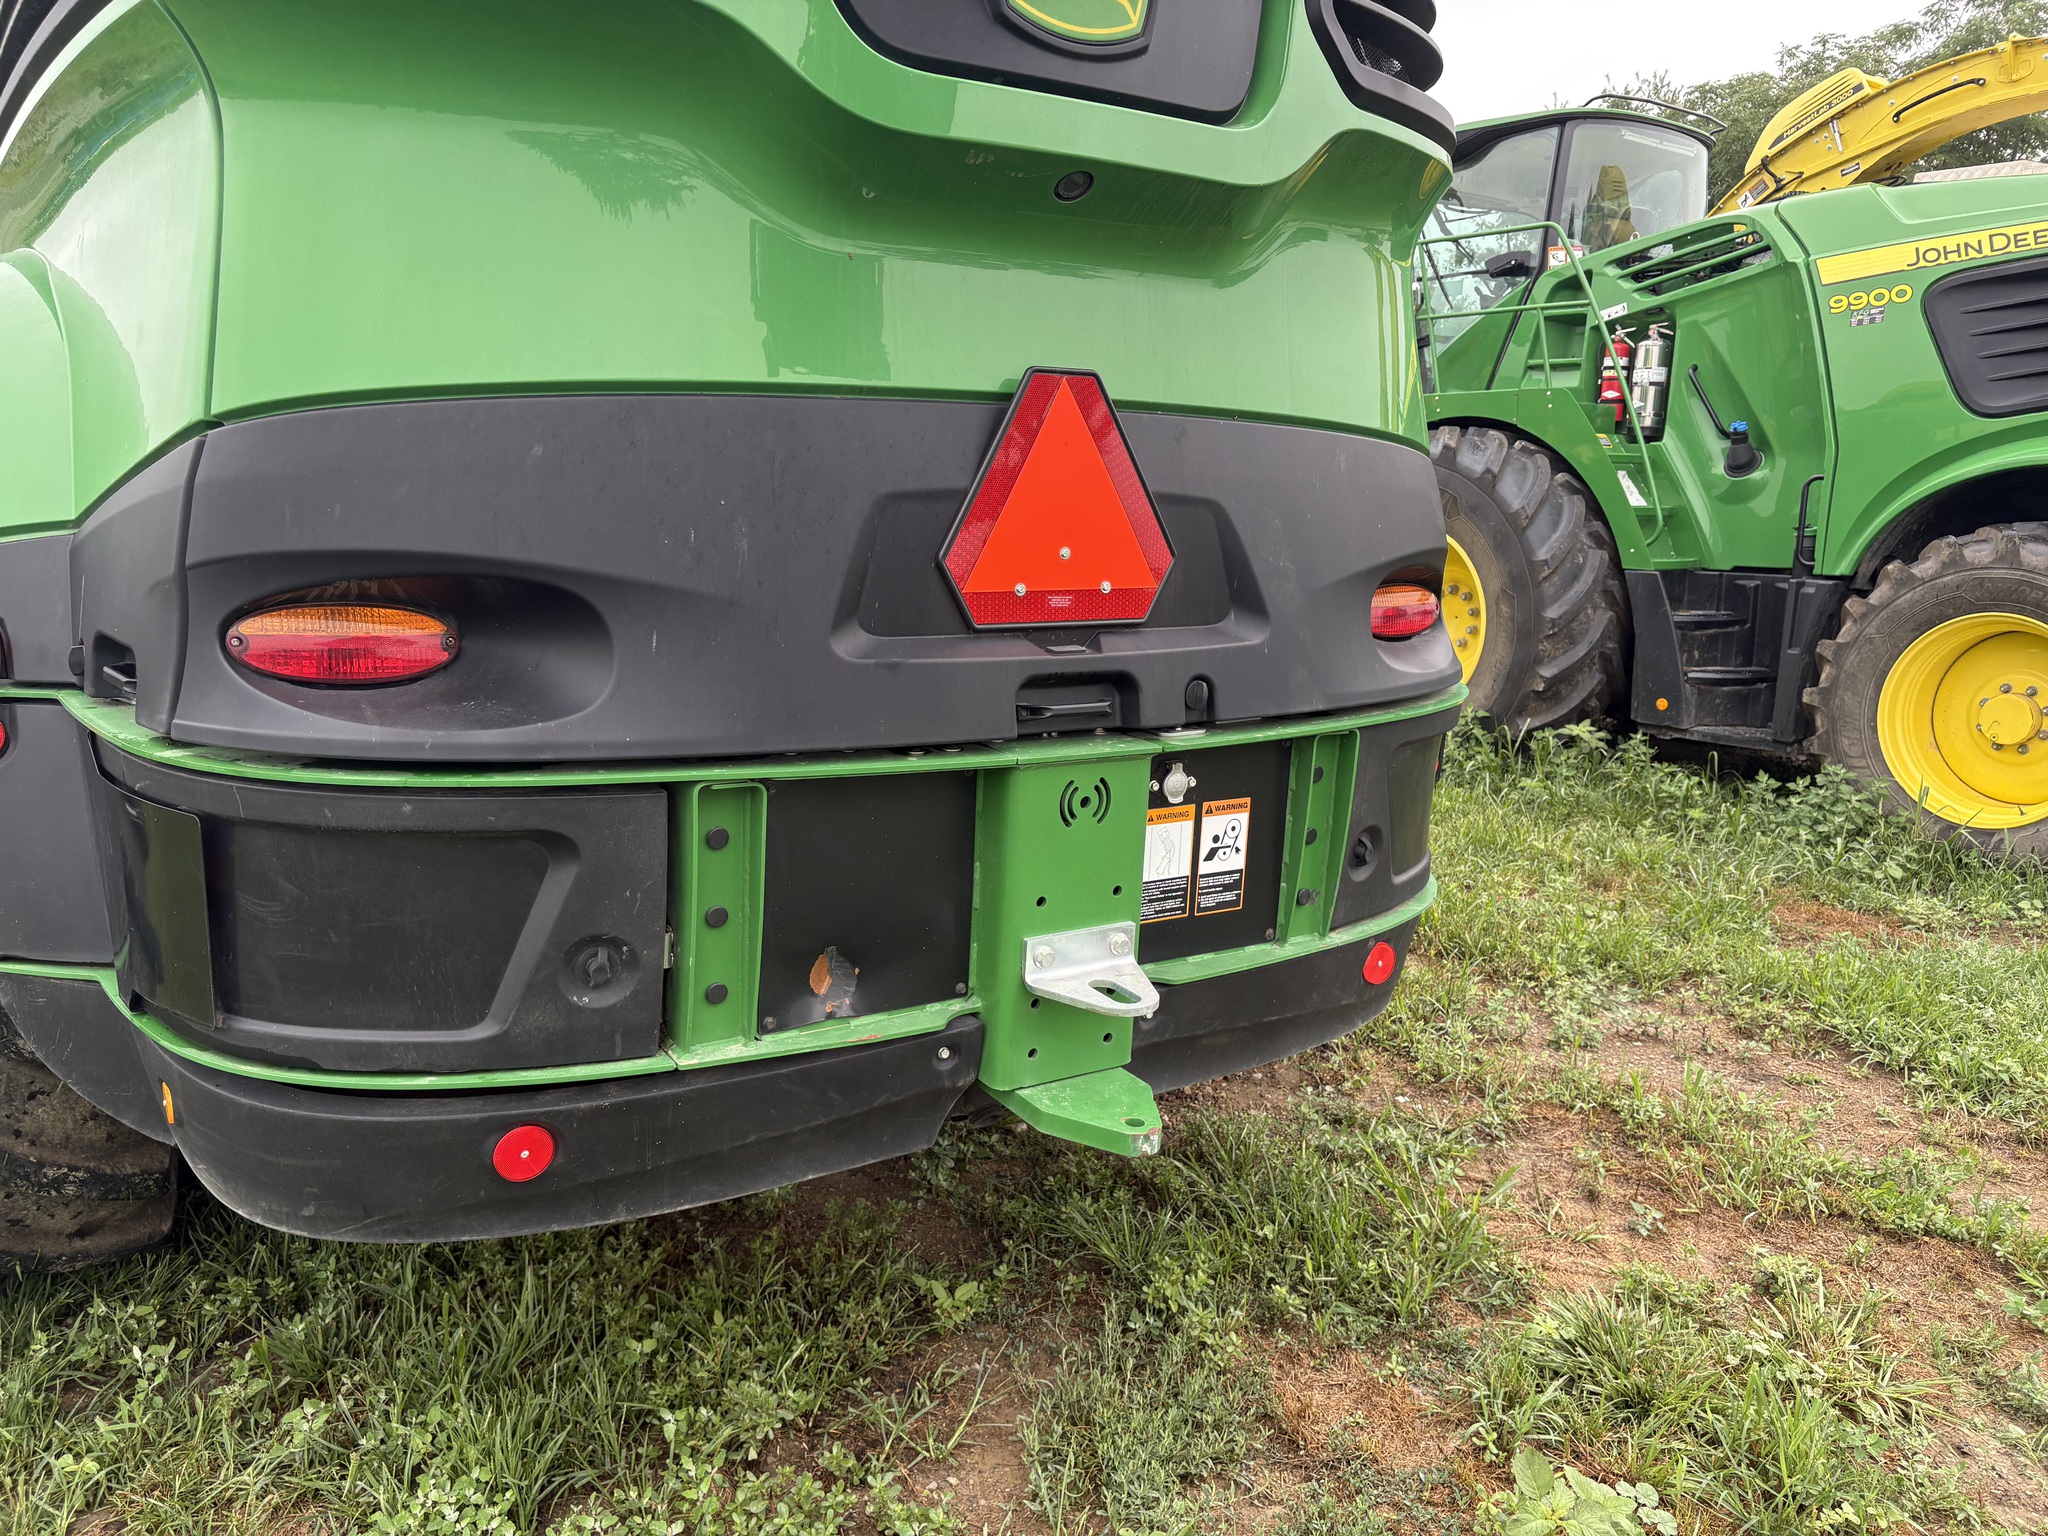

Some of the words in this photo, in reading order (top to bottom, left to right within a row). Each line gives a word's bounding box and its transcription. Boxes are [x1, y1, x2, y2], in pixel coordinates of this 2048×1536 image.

[1782, 103, 1830, 138] HarvestLab
[1831, 89, 1854, 107] 3000
[1907, 239, 1983, 267] JOHN
[1828, 284, 1913, 314] 9900
[1156, 811, 1189, 821] WARNING
[1214, 802, 1248, 812] WARNING
